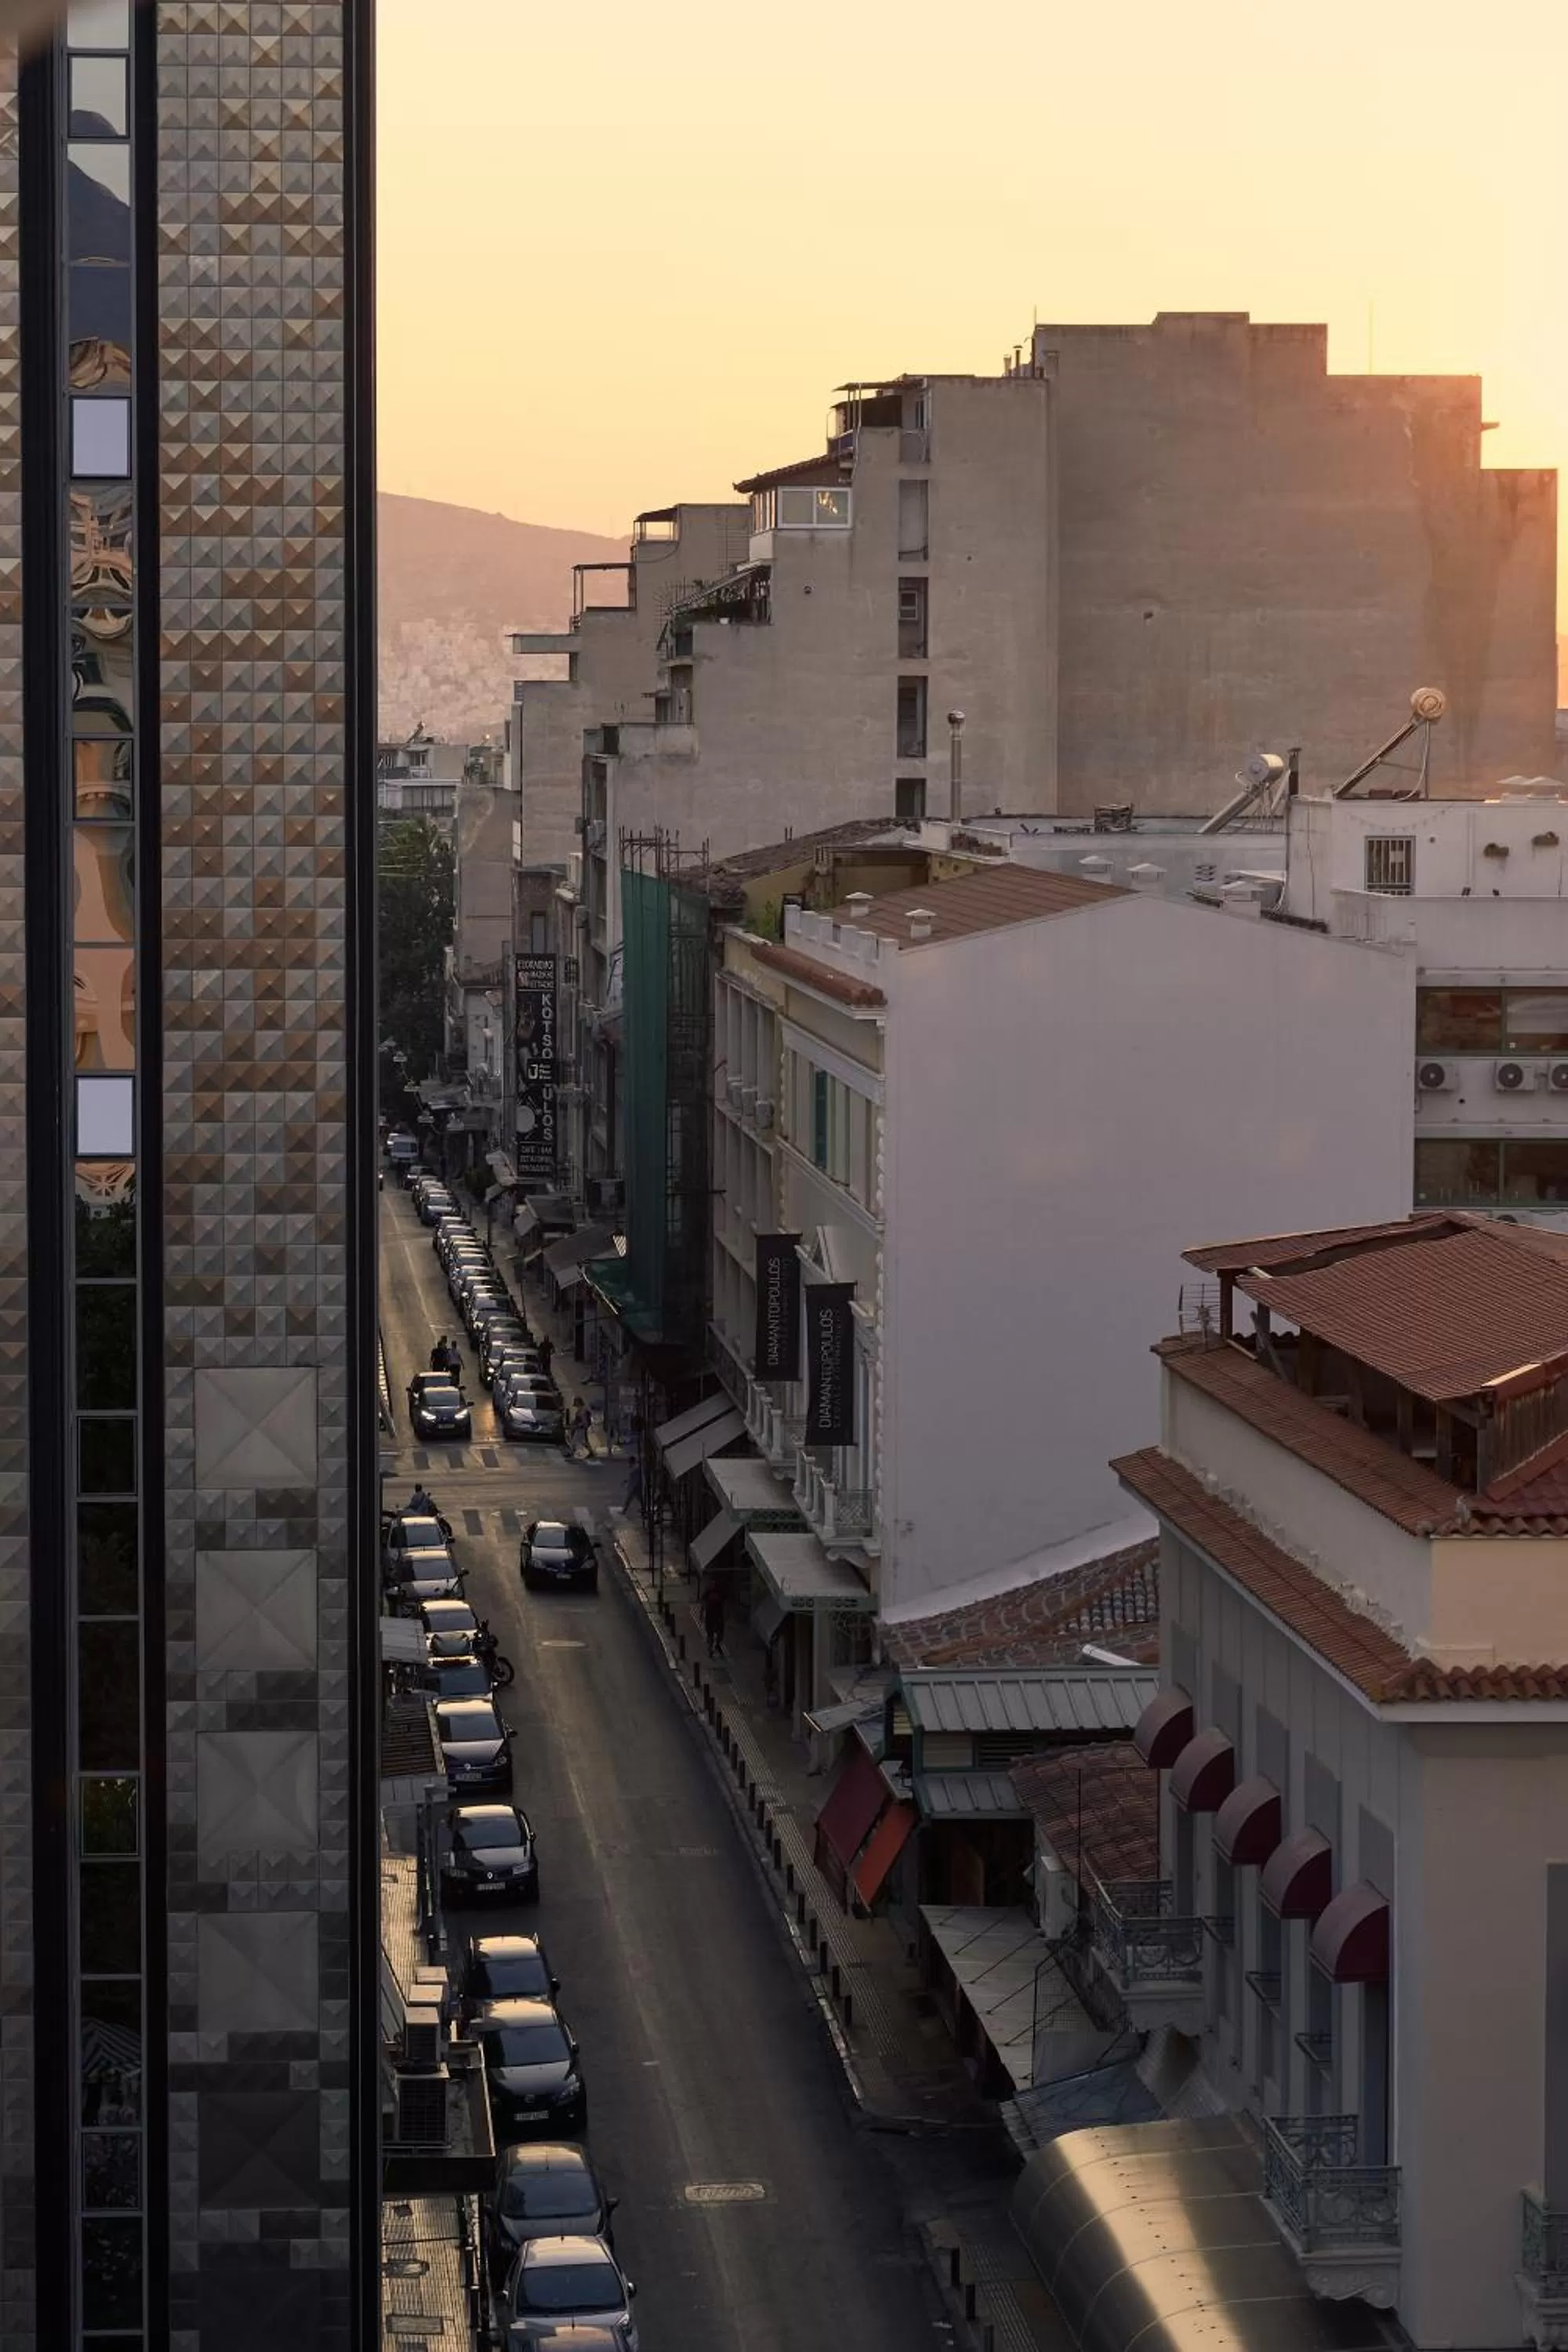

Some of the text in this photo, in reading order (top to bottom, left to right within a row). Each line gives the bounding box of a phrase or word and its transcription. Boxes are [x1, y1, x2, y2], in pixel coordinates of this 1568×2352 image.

[541, 993, 554, 1141] KOTSOULOS
[767, 1256, 780, 1366] DIAMANTOPOULOS
[818, 1307, 833, 1429] DIAMANTOPOULOS
